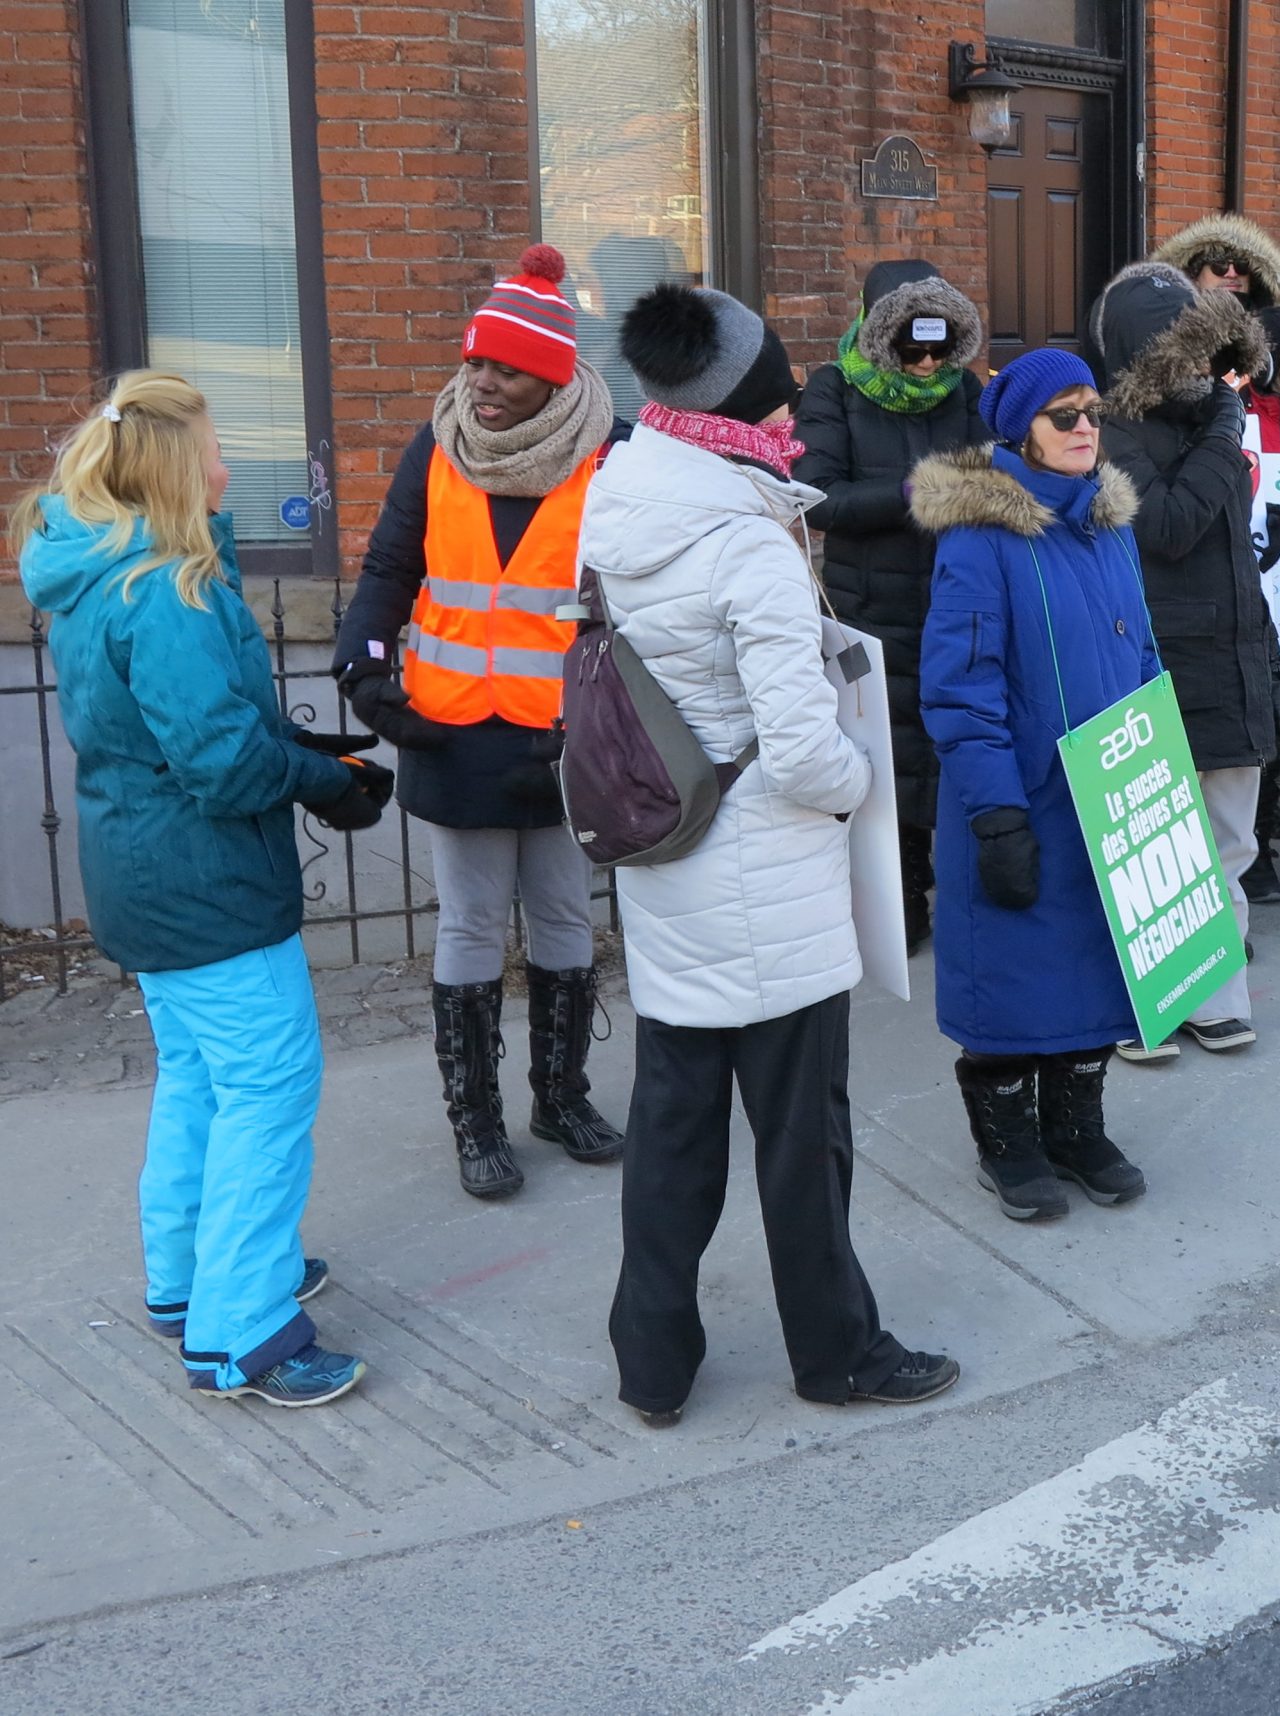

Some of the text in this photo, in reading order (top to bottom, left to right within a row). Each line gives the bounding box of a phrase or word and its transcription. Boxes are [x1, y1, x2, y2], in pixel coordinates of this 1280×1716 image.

[890, 150, 909, 172] 315
[288, 506, 306, 517] ADT
[1100, 776, 1194, 866] des élèves est
[1104, 758, 1172, 824] Le succès
[1108, 808, 1212, 936] NON
[1126, 874, 1224, 982] NÉGOCIABLE
[1156, 946, 1227, 1014] ENSEMBLEPOURAGIR.CA
